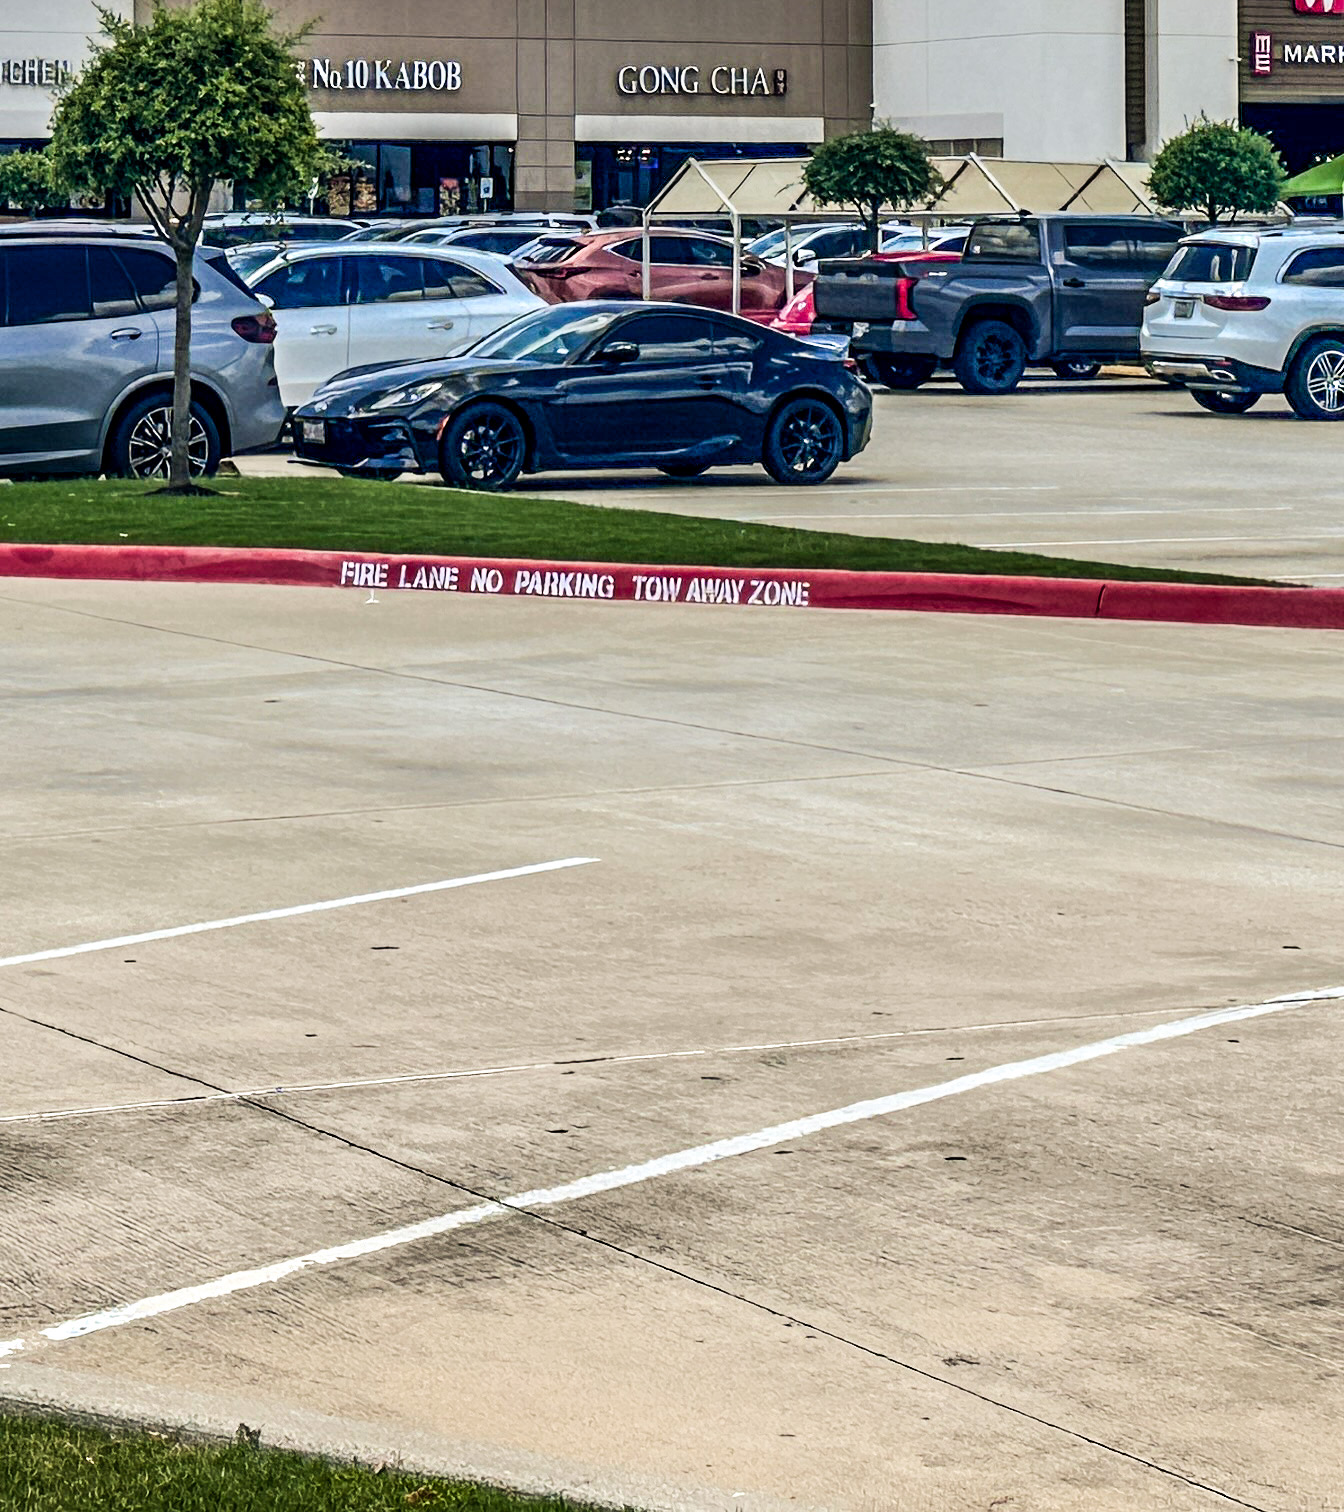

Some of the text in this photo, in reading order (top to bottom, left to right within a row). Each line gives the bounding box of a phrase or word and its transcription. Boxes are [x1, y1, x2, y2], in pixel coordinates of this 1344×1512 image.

[375, 59, 462, 91] KABOB
[617, 65, 699, 94] GONG
[711, 66, 770, 95] CHA
[340, 561, 811, 606] FIRE LANE NO PARKING TOW AWAY ZONE
